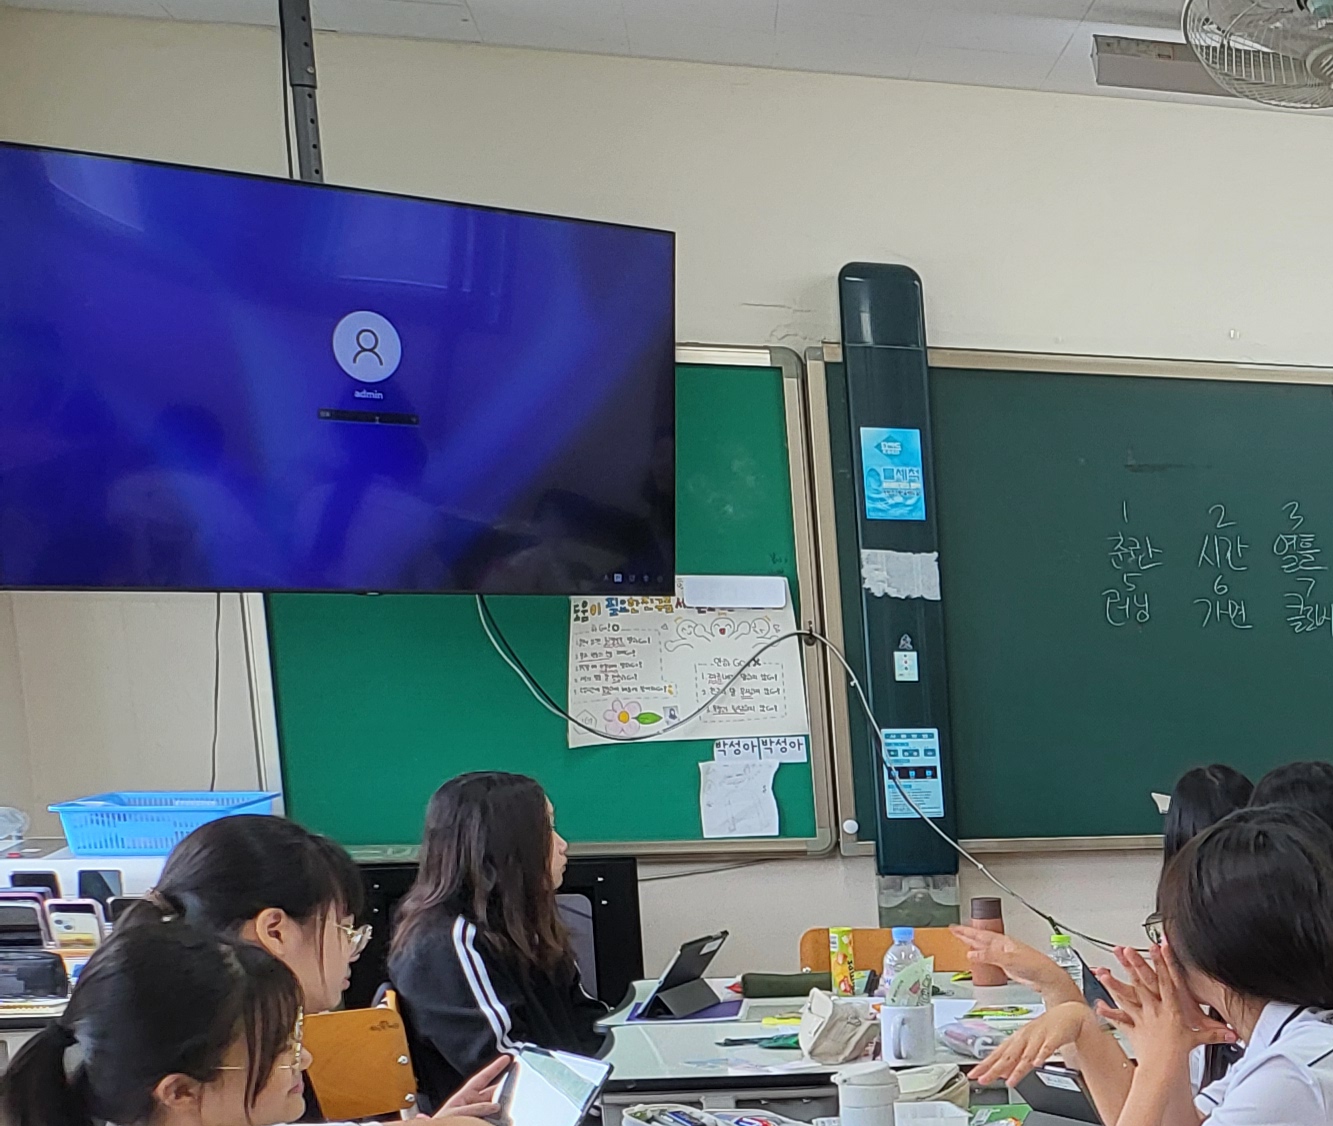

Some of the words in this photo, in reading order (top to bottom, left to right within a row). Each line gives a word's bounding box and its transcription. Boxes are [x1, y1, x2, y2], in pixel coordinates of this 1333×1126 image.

[354, 389, 383, 399] admin
[1208, 504, 1236, 528] 2
[1282, 501, 1304, 530] 3
[1198, 535, 1249, 570] 시간
[1123, 573, 1143, 591] 5
[1214, 575, 1228, 595] 6
[1296, 577, 1316, 598] 7
[1193, 599, 1253, 629] 가면
[716, 740, 757, 756] 박성아
[761, 738, 803, 754] 박성아
